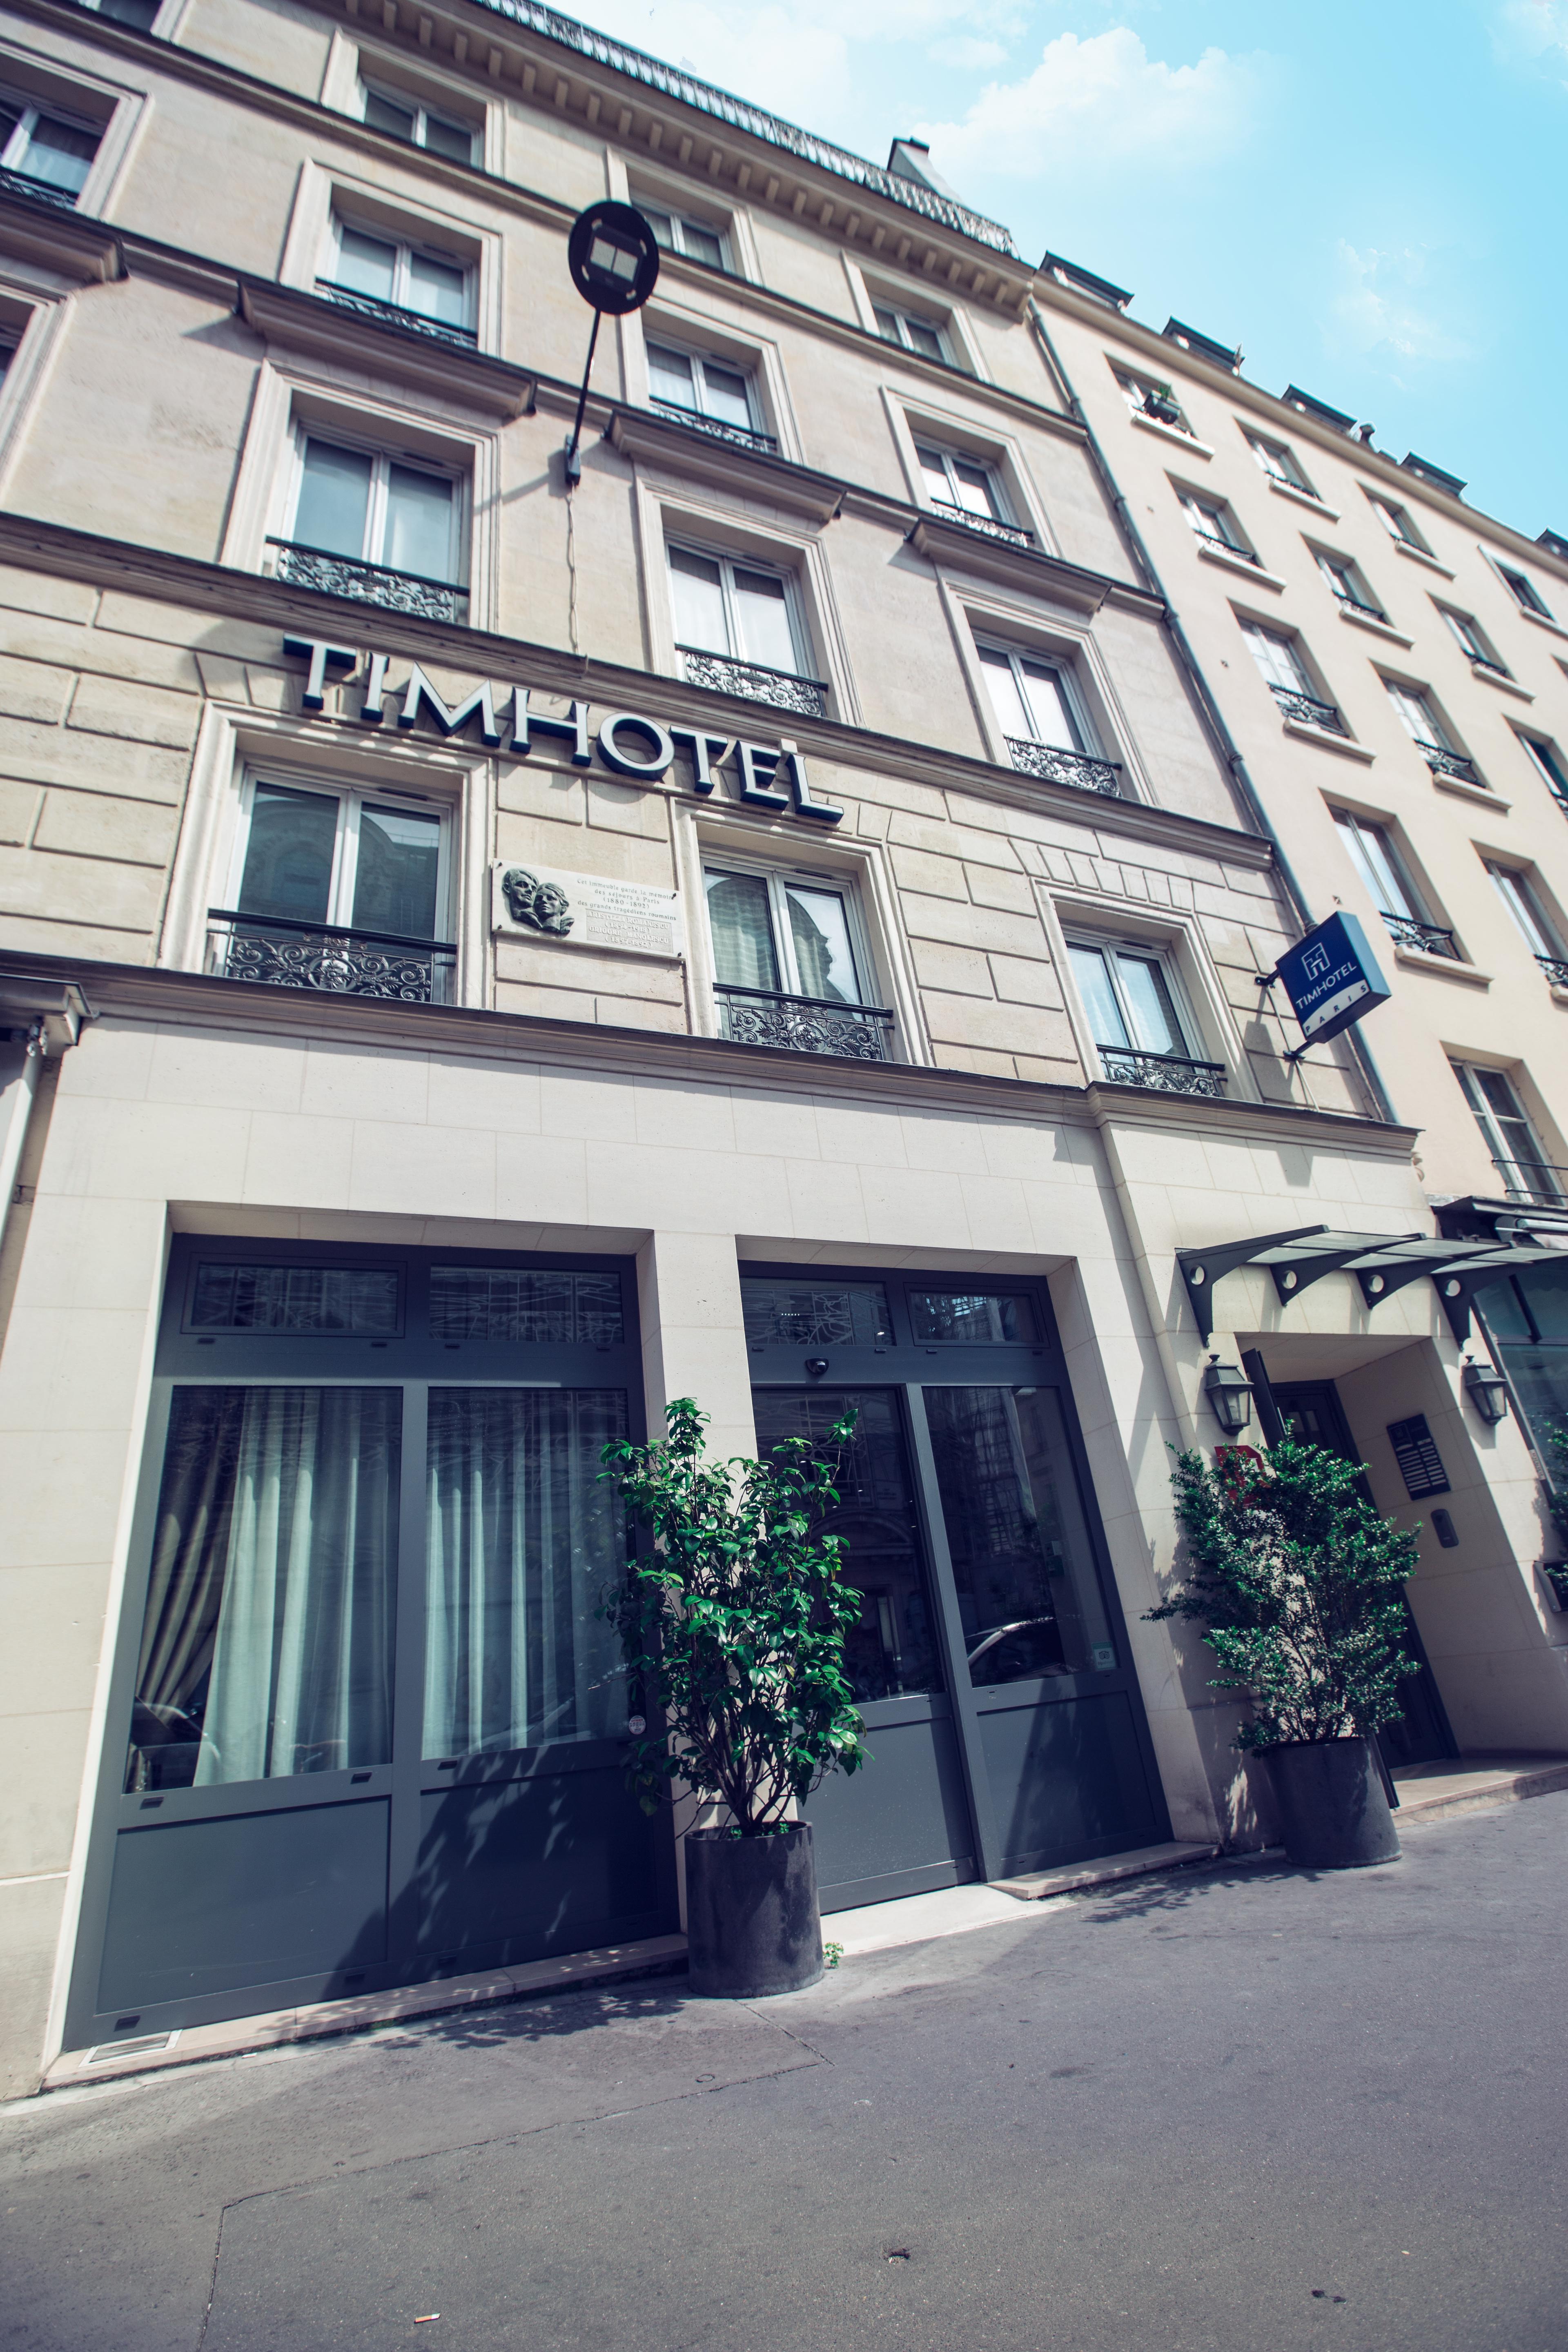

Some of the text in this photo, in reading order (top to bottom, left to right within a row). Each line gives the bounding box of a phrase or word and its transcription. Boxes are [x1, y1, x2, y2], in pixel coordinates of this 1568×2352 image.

[283, 632, 844, 822] TIMHOTEL
[589, 880, 619, 891] immeuble
[608, 892, 633, 900] séjours
[614, 906, 646, 915] tragédiens
[648, 912, 677, 921] roumains
[626, 917, 669, 930] ROMANESCU
[626, 931, 669, 944] MANOLESCU
[1295, 962, 1357, 1009] TIMHOTEL
[1305, 984, 1367, 1033] PARIS
